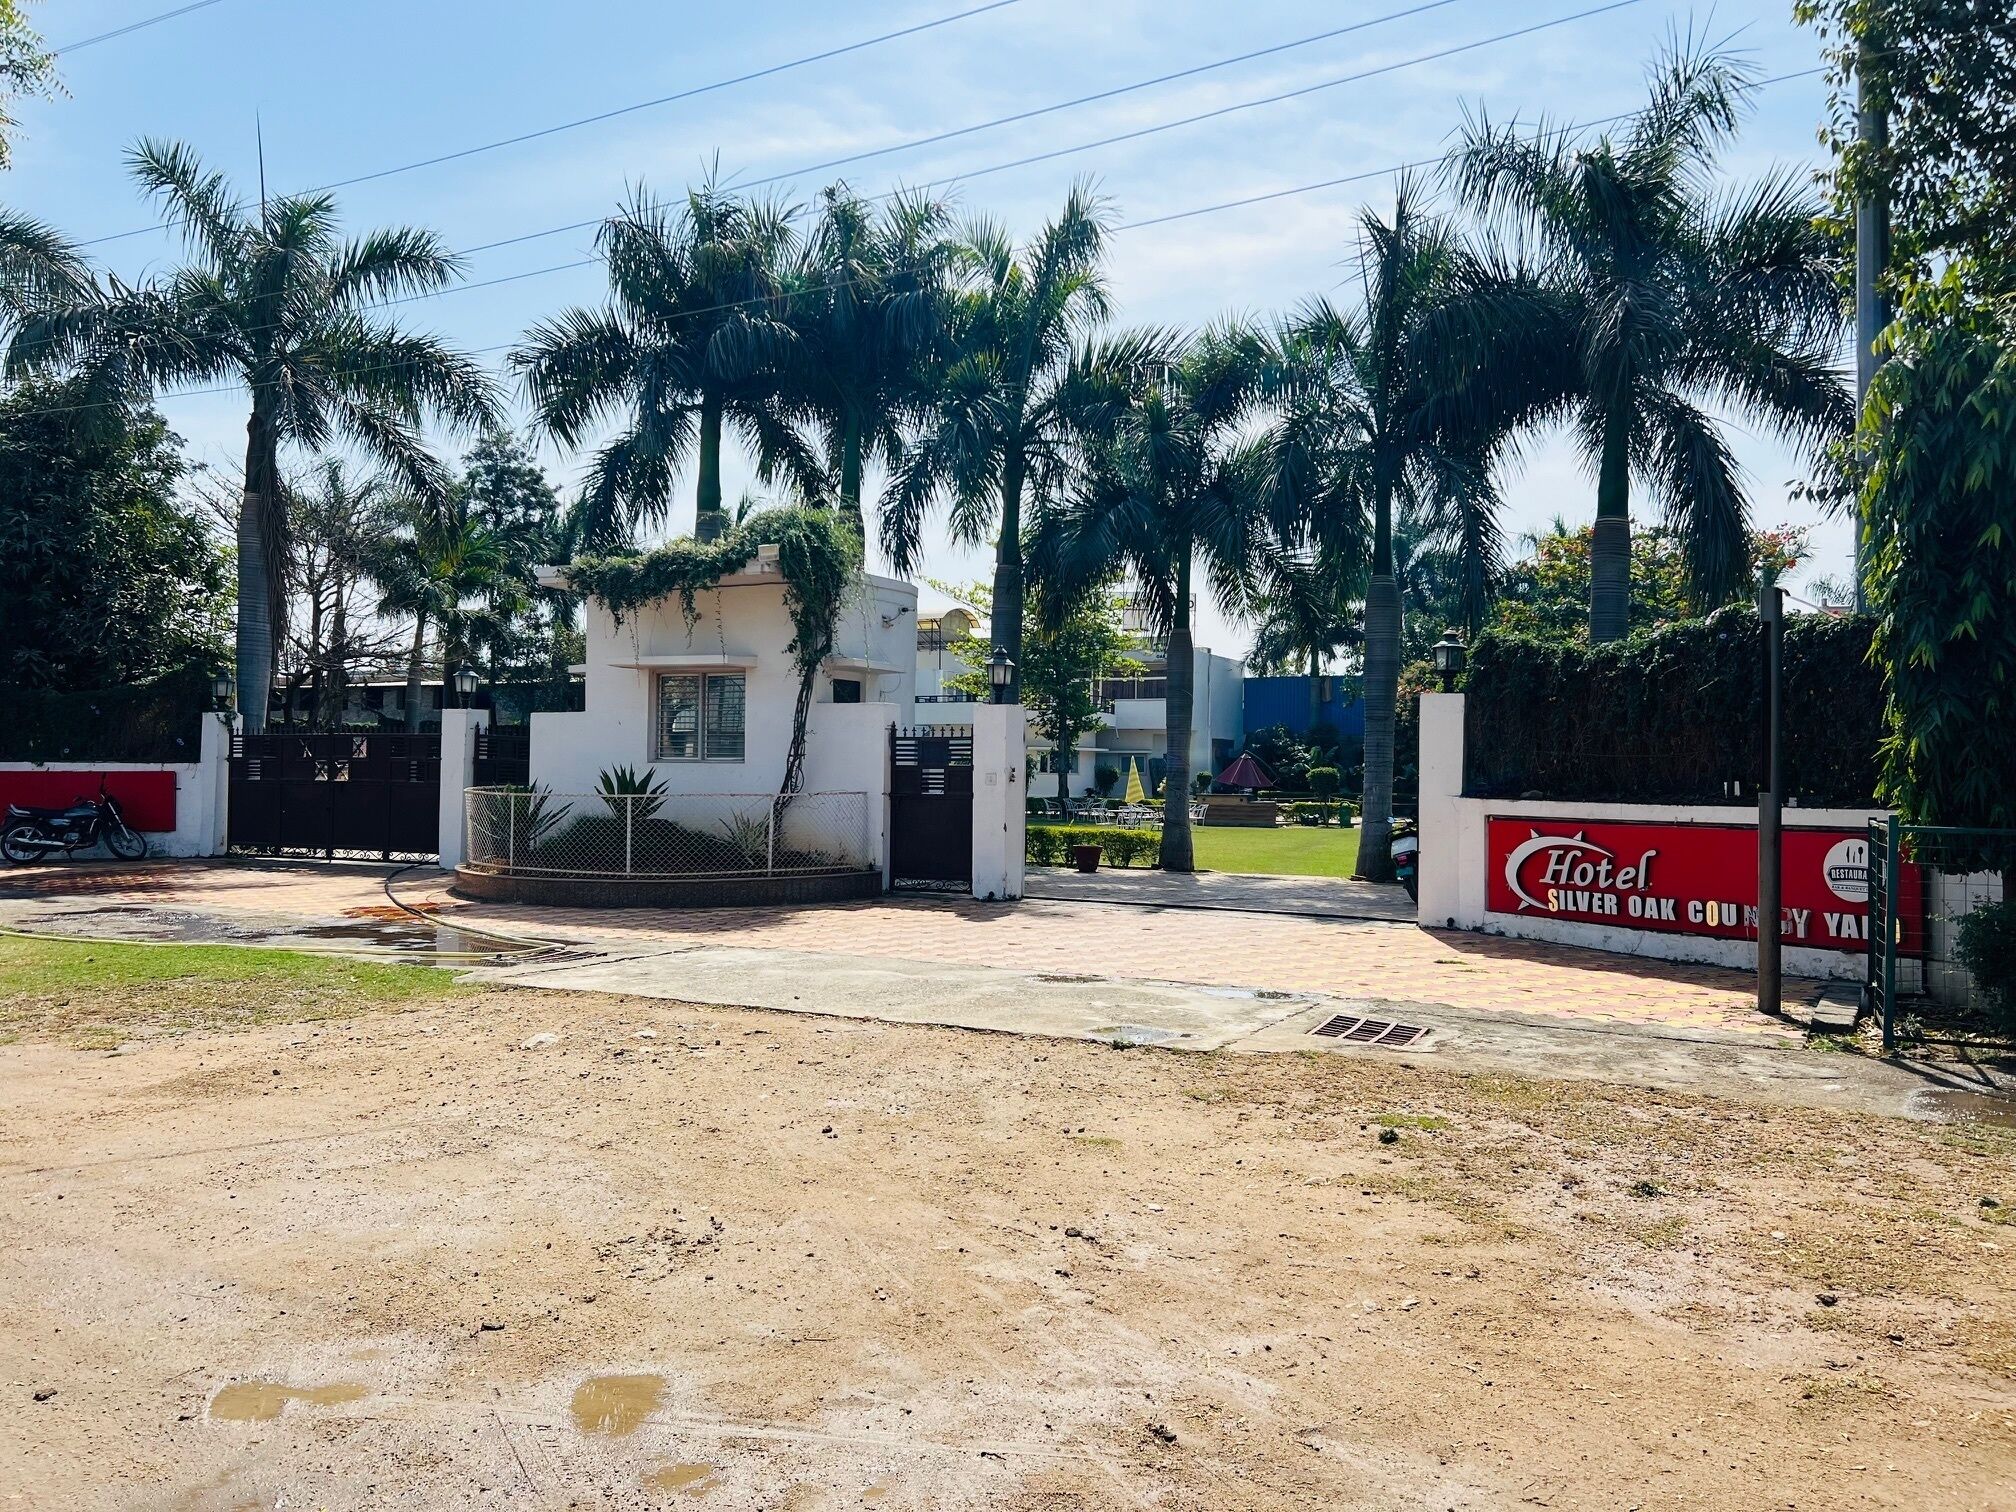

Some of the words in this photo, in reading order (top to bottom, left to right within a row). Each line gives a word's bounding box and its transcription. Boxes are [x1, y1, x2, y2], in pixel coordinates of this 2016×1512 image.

[1539, 849, 1657, 892] Hotel
[1831, 868, 1868, 880] RESTAURA
[1547, 888, 1618, 916] SILVER
[1628, 895, 1676, 921] OAK
[1687, 900, 1811, 939] COUNRY
[1823, 912, 1901, 945] YA
